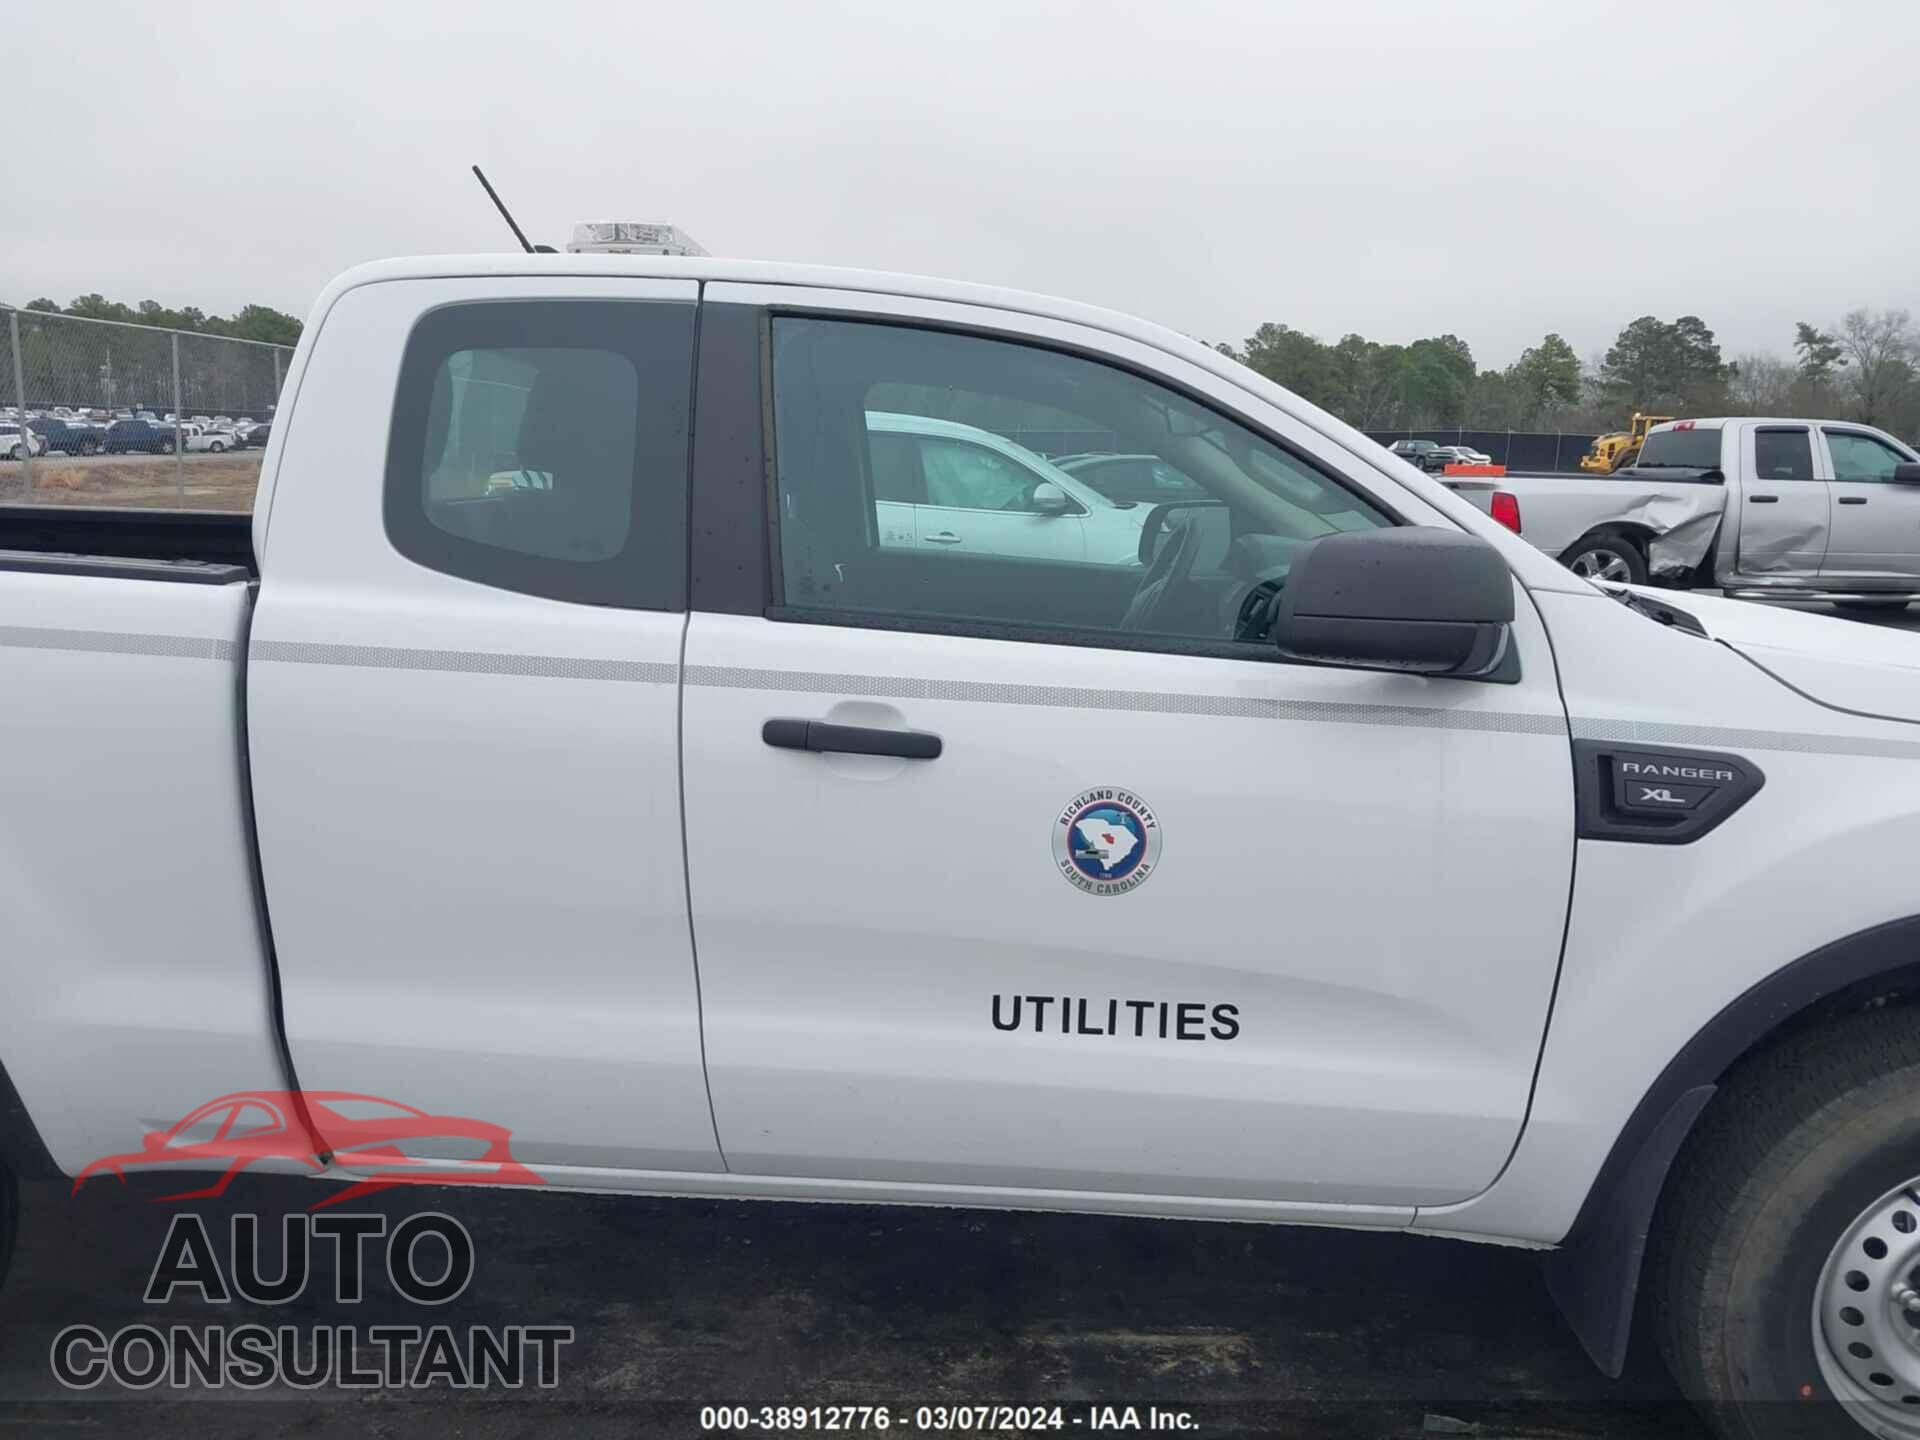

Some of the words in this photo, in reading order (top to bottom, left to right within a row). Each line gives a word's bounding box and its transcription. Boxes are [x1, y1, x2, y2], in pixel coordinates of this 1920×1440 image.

[1623, 762, 1733, 781] RANGER
[1060, 790, 1113, 826] RICHLAND
[1118, 792, 1156, 829] COUNTY
[1640, 787, 1686, 803] XL
[1061, 859, 1093, 890] SOUTH
[1097, 863, 1151, 893] CAROLINA
[992, 995, 1239, 1040] UTILITIES
